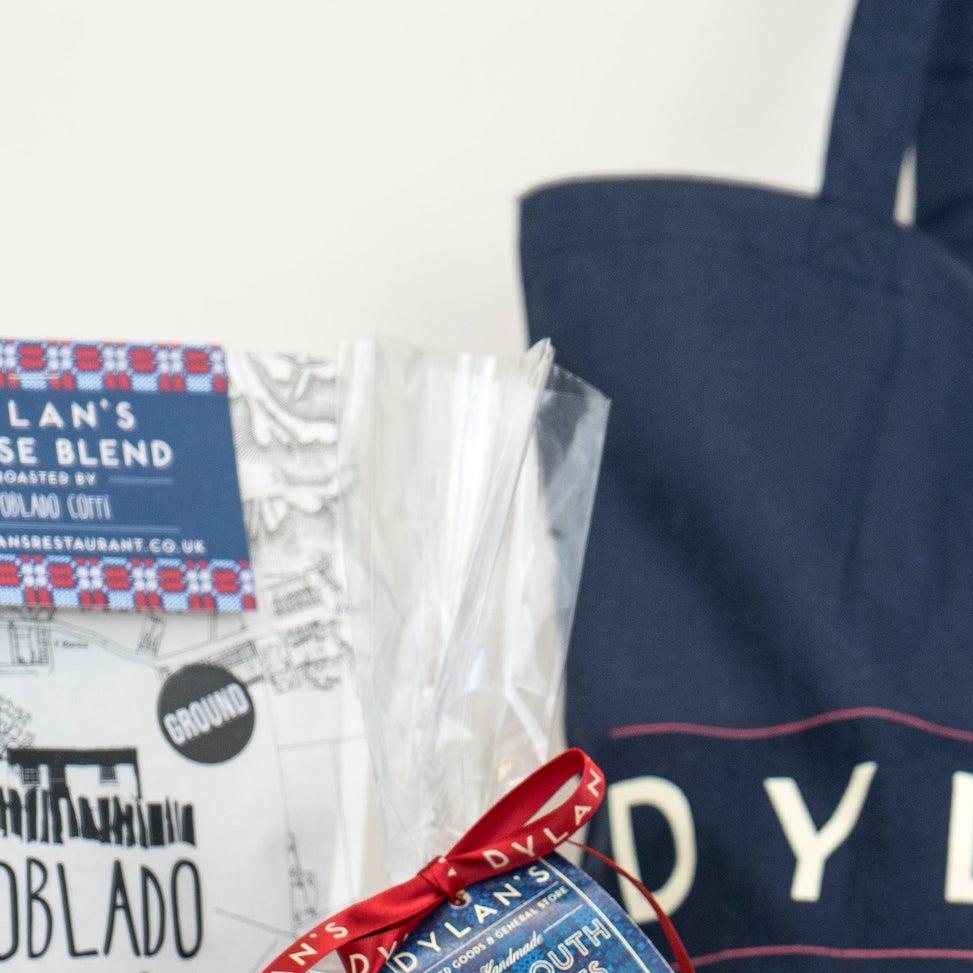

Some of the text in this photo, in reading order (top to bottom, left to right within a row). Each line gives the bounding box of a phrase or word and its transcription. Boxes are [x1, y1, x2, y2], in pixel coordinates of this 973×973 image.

[8, 398, 137, 430] LAN'S
[55, 438, 174, 468] BLEND
[0, 470, 96, 486] OASTED BY
[163, 682, 249, 745] GROUND
[393, 865, 550, 973] DYLAN'S
[453, 941, 487, 971] GOODS
[495, 908, 539, 940] GENERAL
[537, 886, 569, 917] STORE
